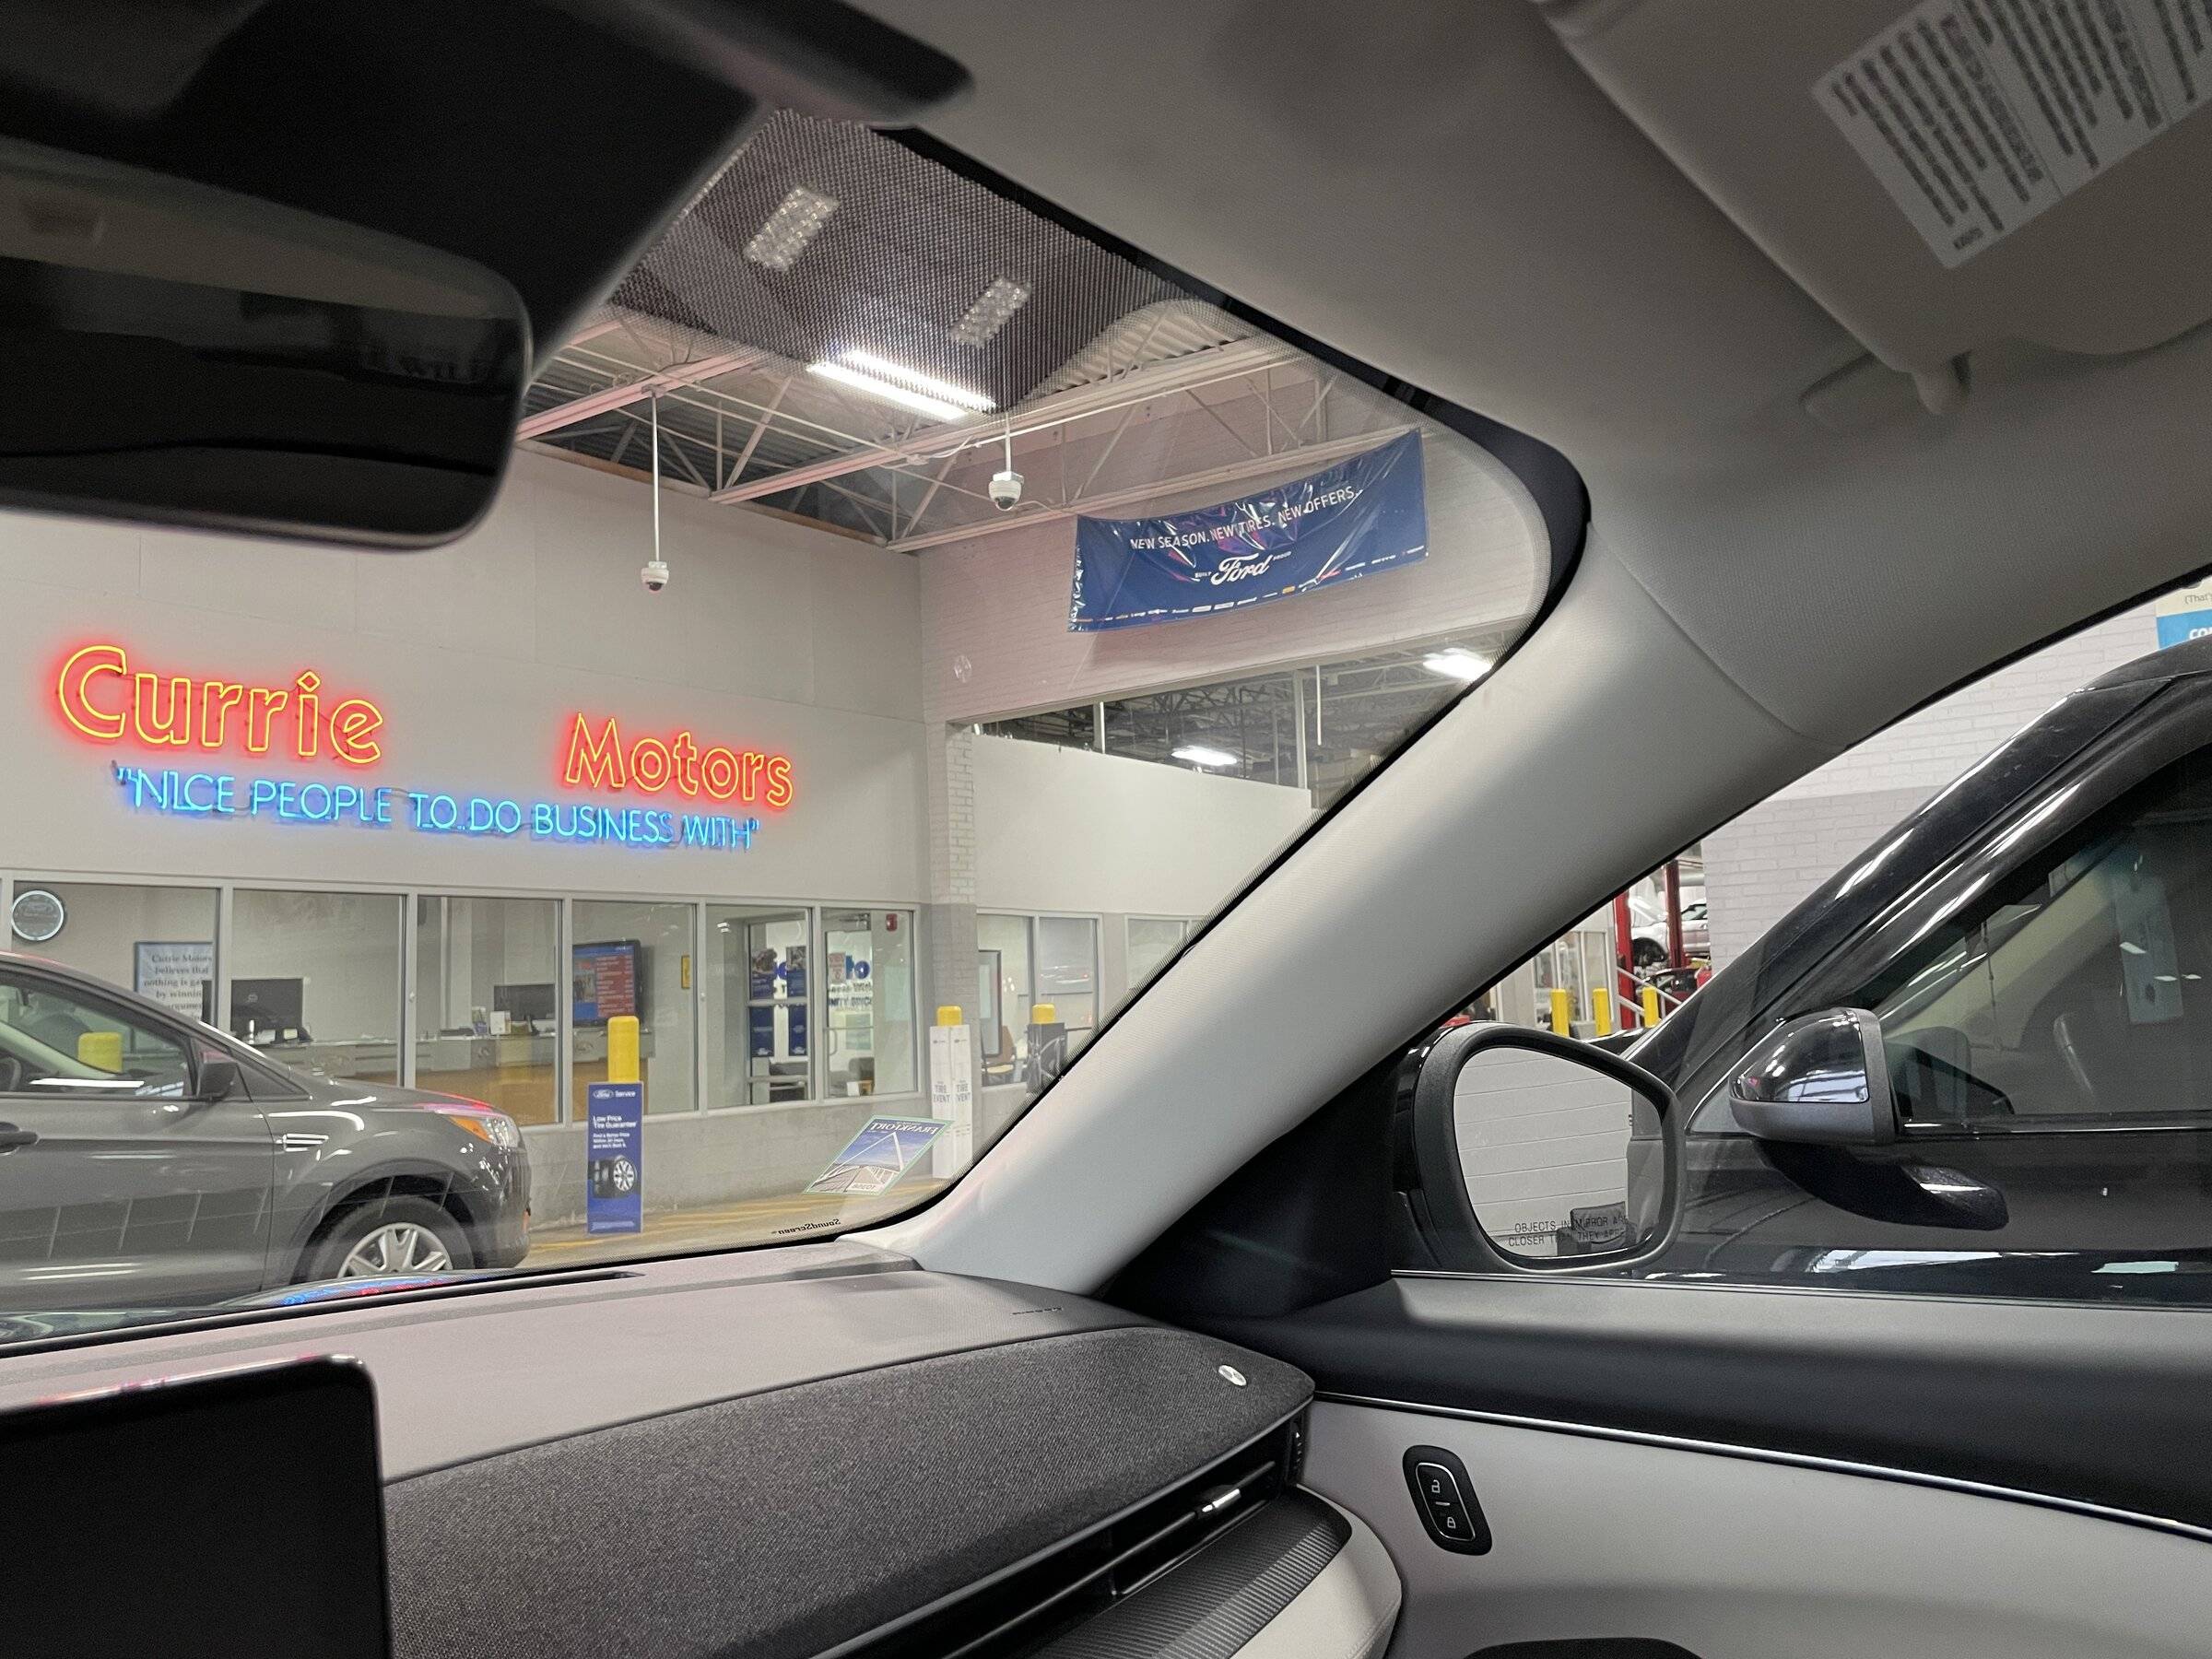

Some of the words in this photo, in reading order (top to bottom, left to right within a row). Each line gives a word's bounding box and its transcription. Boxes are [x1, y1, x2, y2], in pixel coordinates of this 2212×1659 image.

[1159, 532, 1210, 549] SEASON.
[1210, 525, 1235, 542] NEW
[1237, 514, 1276, 535] TIRES.
[1277, 503, 1302, 524] NEW
[1304, 485, 1359, 514] OFFERS.
[1210, 552, 1274, 585] Ford
[58, 644, 383, 764] Currie
[565, 712, 794, 808] Motors
[115, 766, 236, 814] "NICE
[251, 779, 393, 822] PEOPLE
[408, 792, 458, 829] TO
[469, 797, 522, 833] DO
[534, 803, 674, 844] BUSINESS
[681, 814, 760, 850] WITH"
[1508, 1235, 1545, 1247] CLOSER
[1514, 1220, 1557, 1233] OBJECTS
[1560, 1218, 1571, 1230] IN
